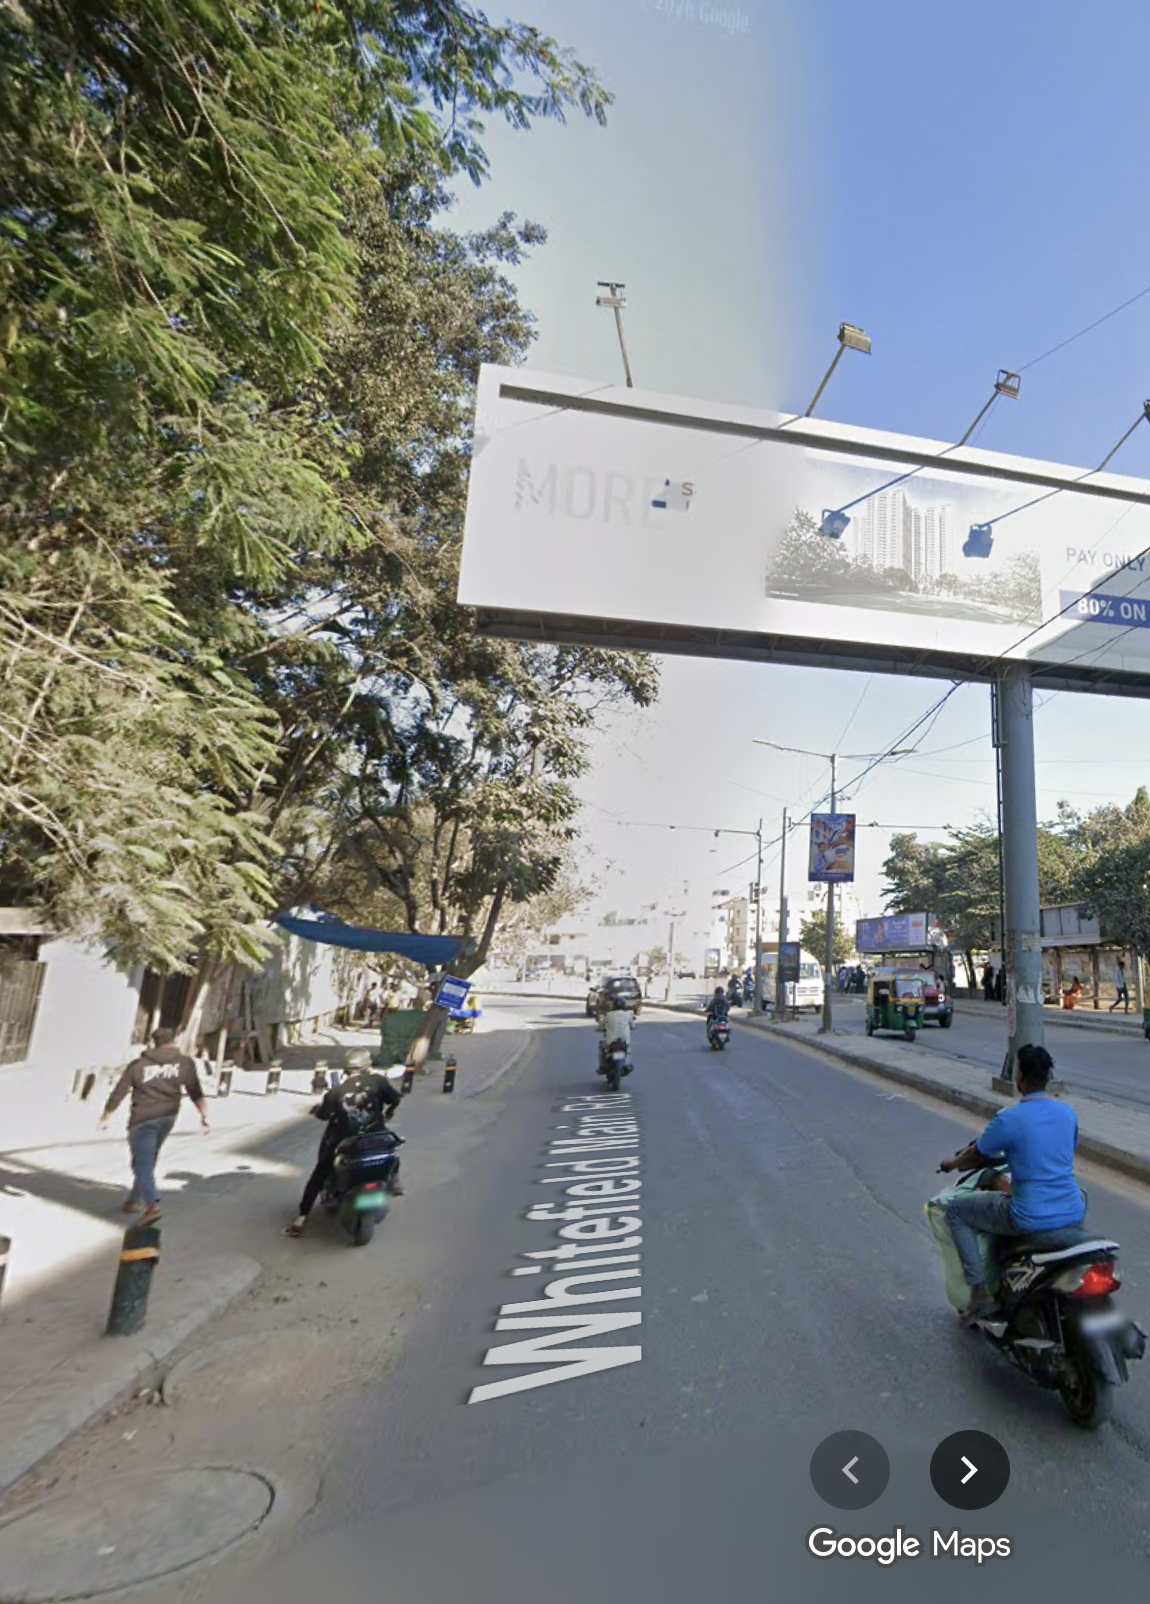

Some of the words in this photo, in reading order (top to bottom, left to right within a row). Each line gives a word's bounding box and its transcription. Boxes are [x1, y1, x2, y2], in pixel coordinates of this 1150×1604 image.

[1066, 547, 1096, 565] PAY
[1103, 552, 1146, 573] ONLY
[1077, 598, 1115, 618] 80%
[1120, 602, 1147, 622] ON
